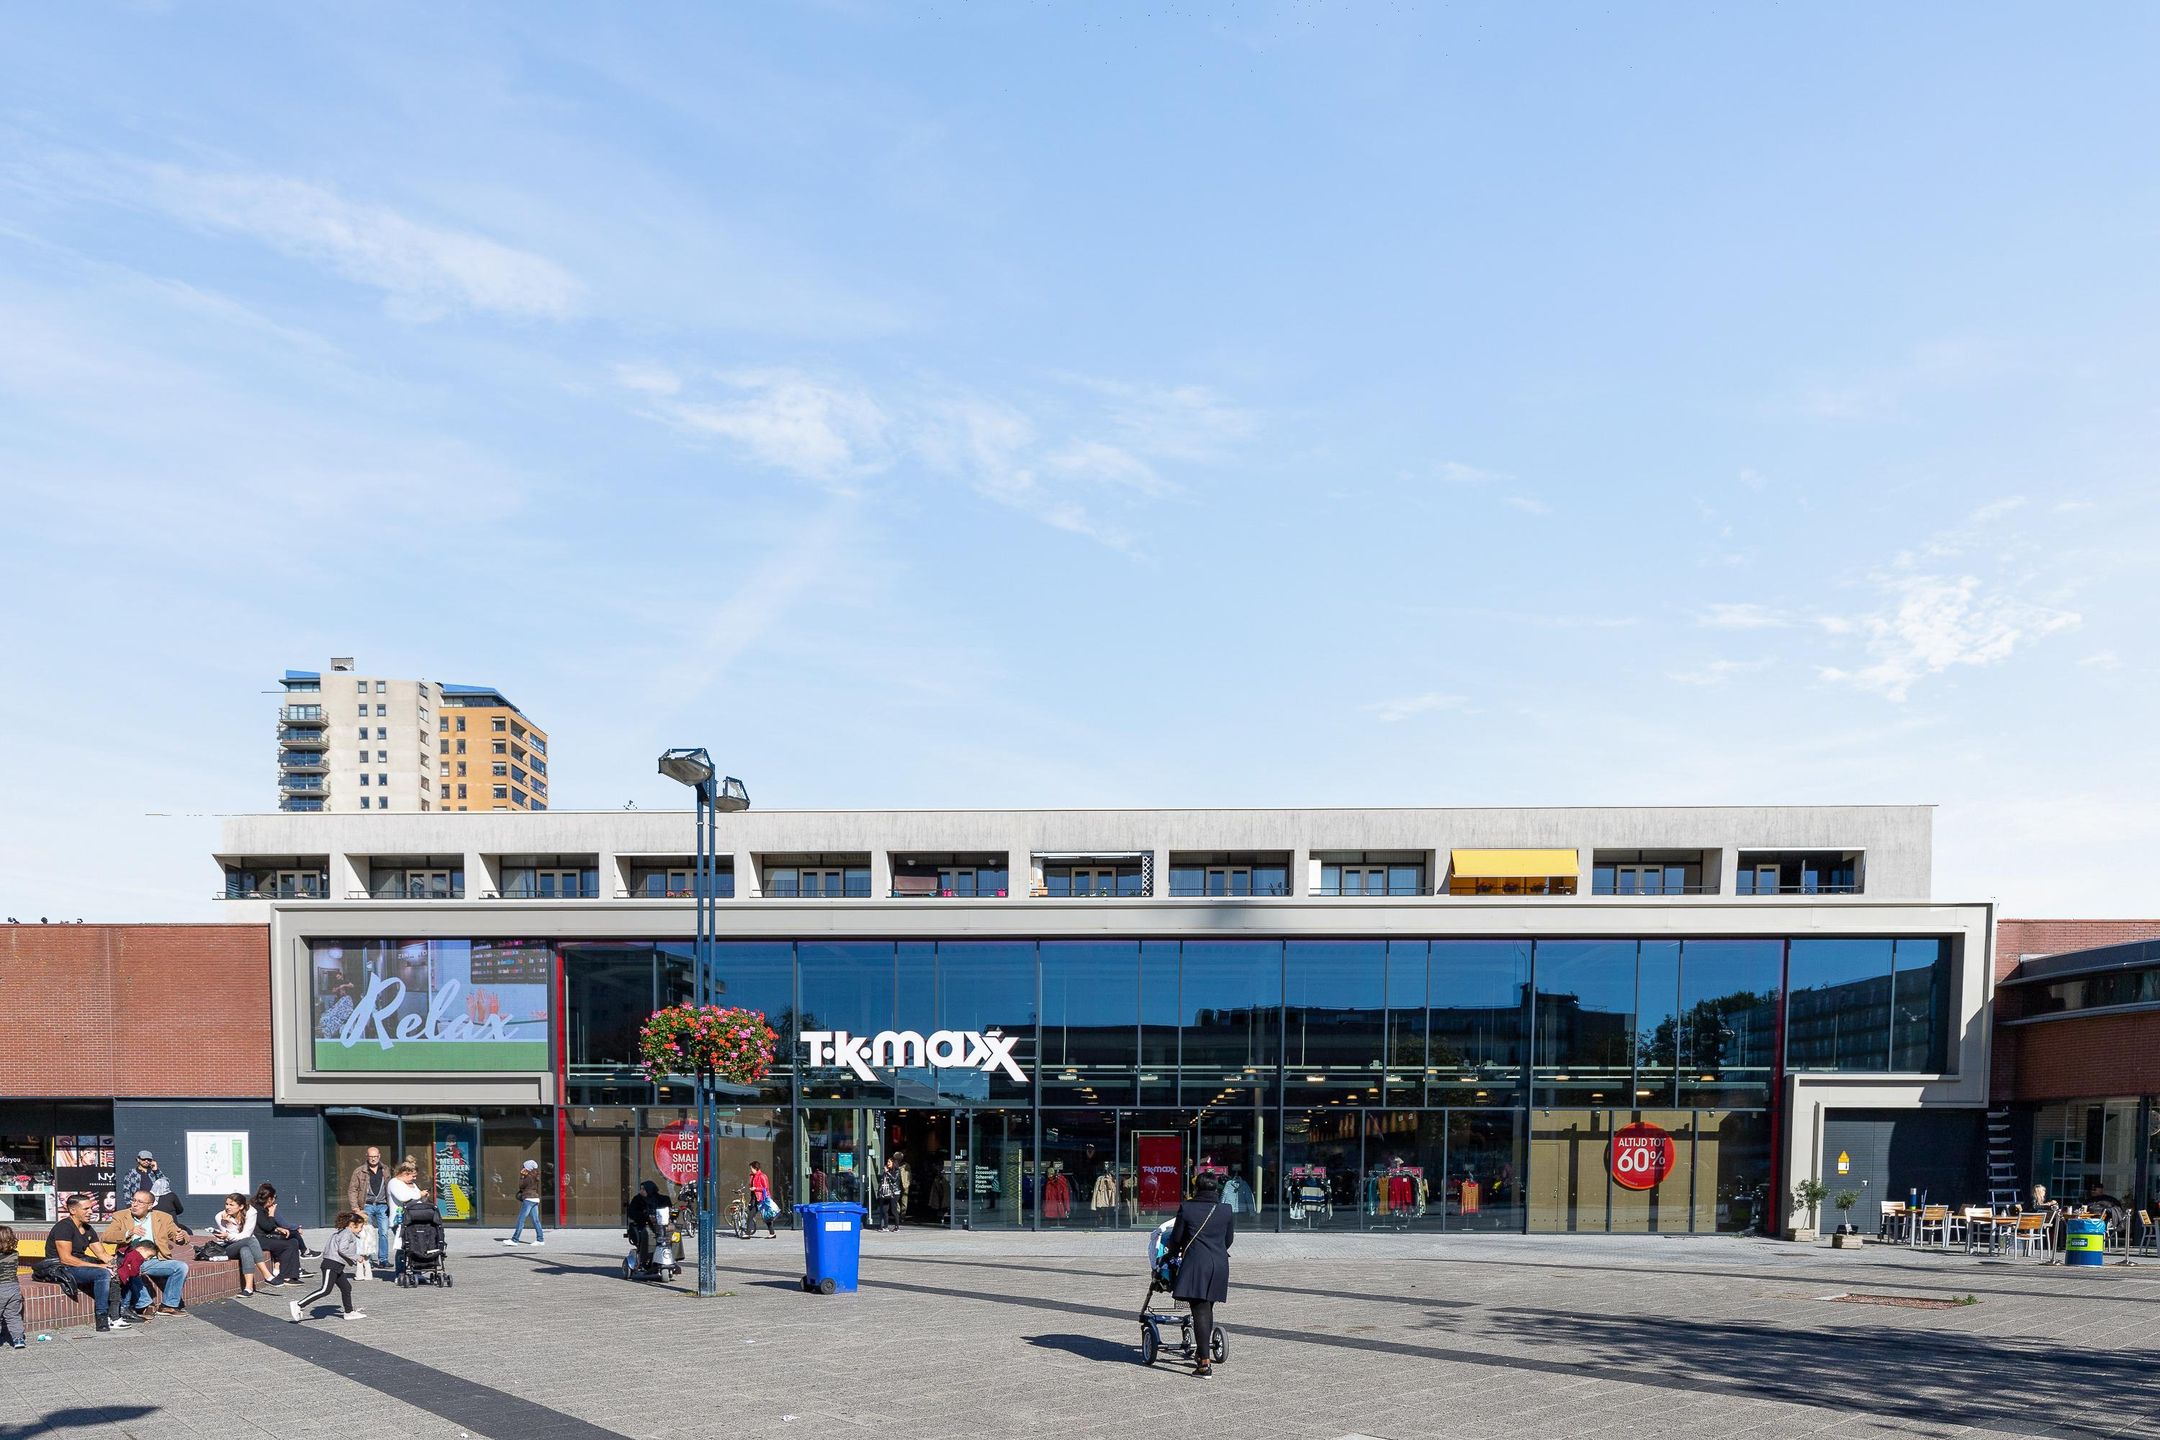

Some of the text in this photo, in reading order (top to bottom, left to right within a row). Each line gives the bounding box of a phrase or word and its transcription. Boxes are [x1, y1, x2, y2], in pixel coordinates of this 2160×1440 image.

[340, 972, 519, 1050] Relax
[678, 1131, 694, 1140] BIG
[1618, 1137, 1667, 1147] ALTIJD TOT
[1617, 1147, 1666, 1172] 60%
[671, 1163, 698, 1173] PRICE
